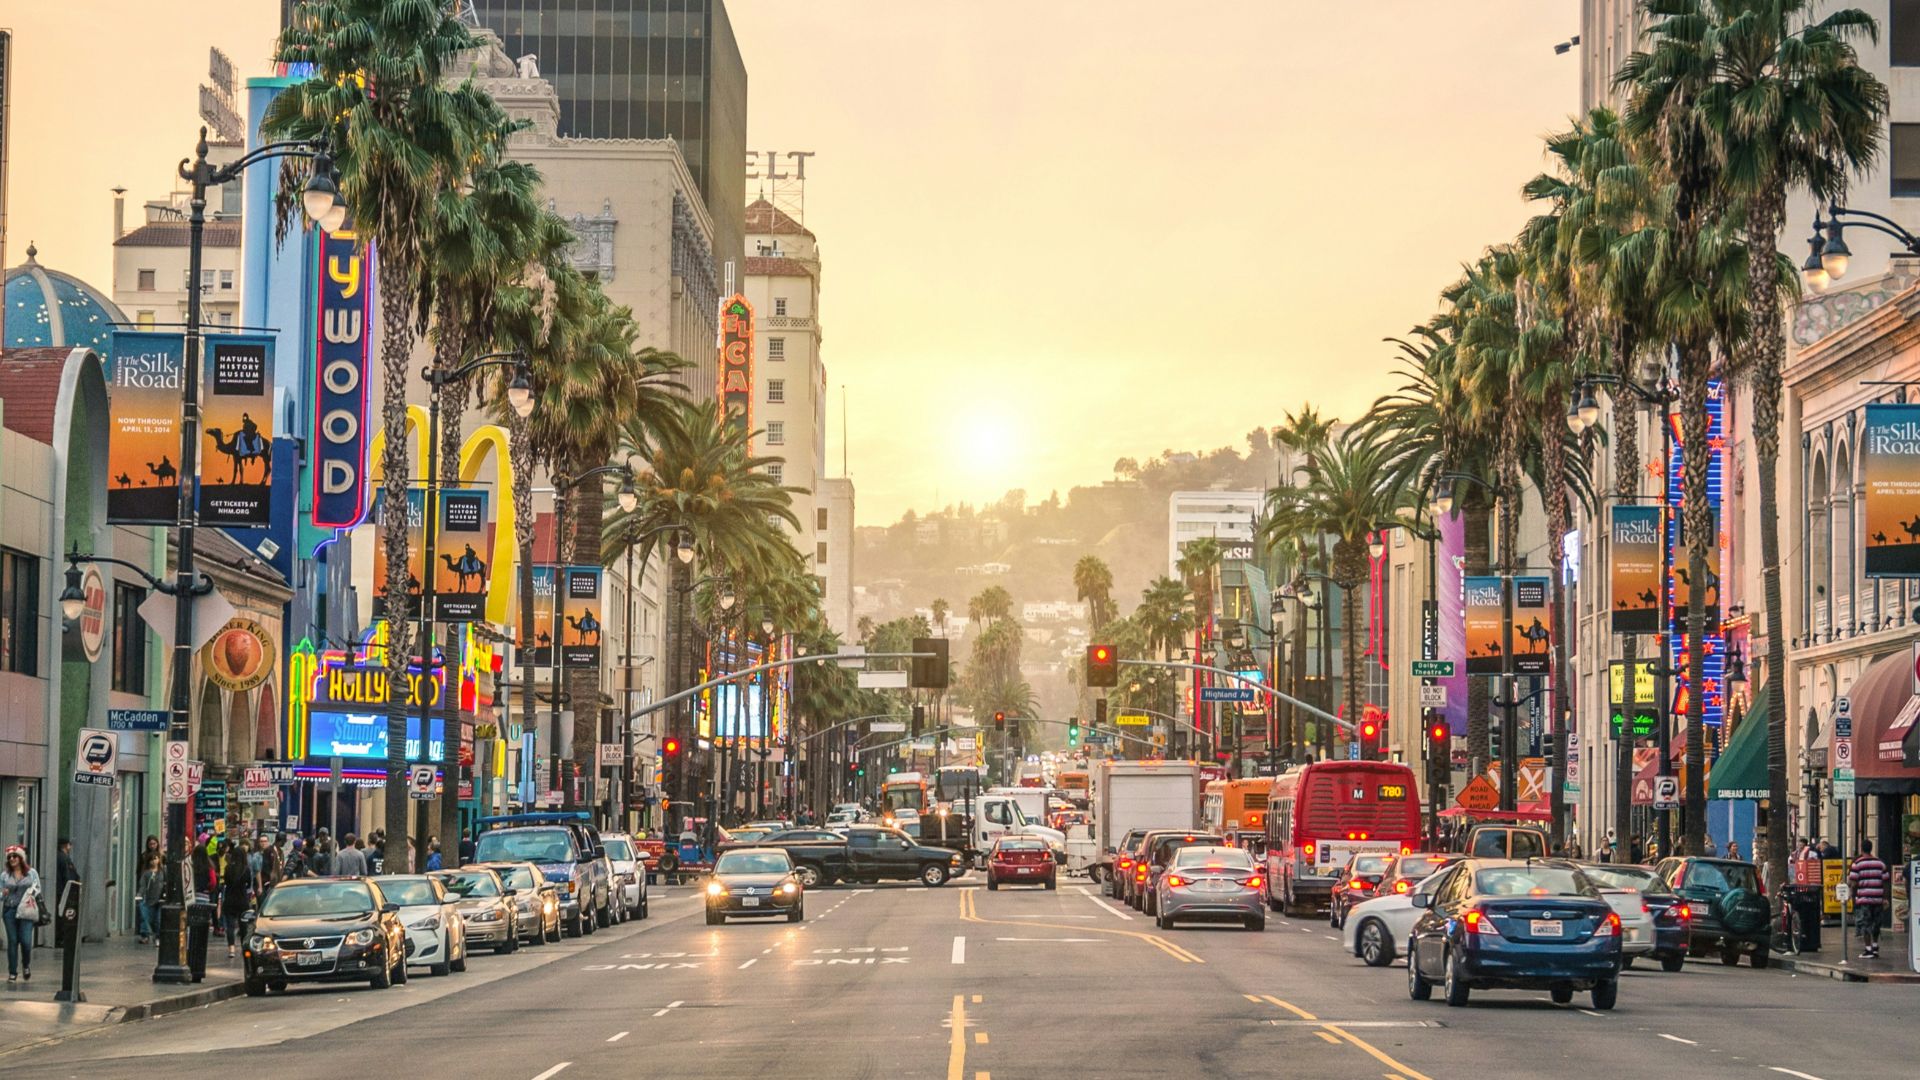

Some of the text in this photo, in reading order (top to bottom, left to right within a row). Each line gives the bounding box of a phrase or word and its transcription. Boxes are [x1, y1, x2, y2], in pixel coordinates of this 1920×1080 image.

[125, 352, 175, 373] The Silk
[219, 355, 260, 363] NATURAL
[323, 230, 361, 494] YWOOD
[124, 366, 179, 389] Road
[117, 417, 173, 426] NOW THROUGH
[121, 425, 142, 433] APRIL
[153, 426, 171, 434] 2014
[1876, 422, 1920, 440] The Silk
[1630, 519, 1653, 533] Silk
[1620, 528, 1657, 544] Road
[1479, 586, 1498, 598] Silk
[1471, 594, 1500, 606] Road
[247, 622, 270, 648] KING
[1418, 662, 1438, 670] Dolby
[213, 672, 260, 689] Since 1989
[329, 668, 440, 706] HOLLYOOD
[1205, 691, 1237, 699] Highland
[110, 711, 158, 722] McCadden
[110, 721, 126, 729] 1700
[128, 721, 133, 729] N
[247, 769, 269, 782] ATM
[268, 767, 293, 779] ATM
[77, 774, 112, 786] PAY HERE
[1382, 785, 1402, 797] 780
[1718, 789, 1770, 798] CAMERAS GALOR
